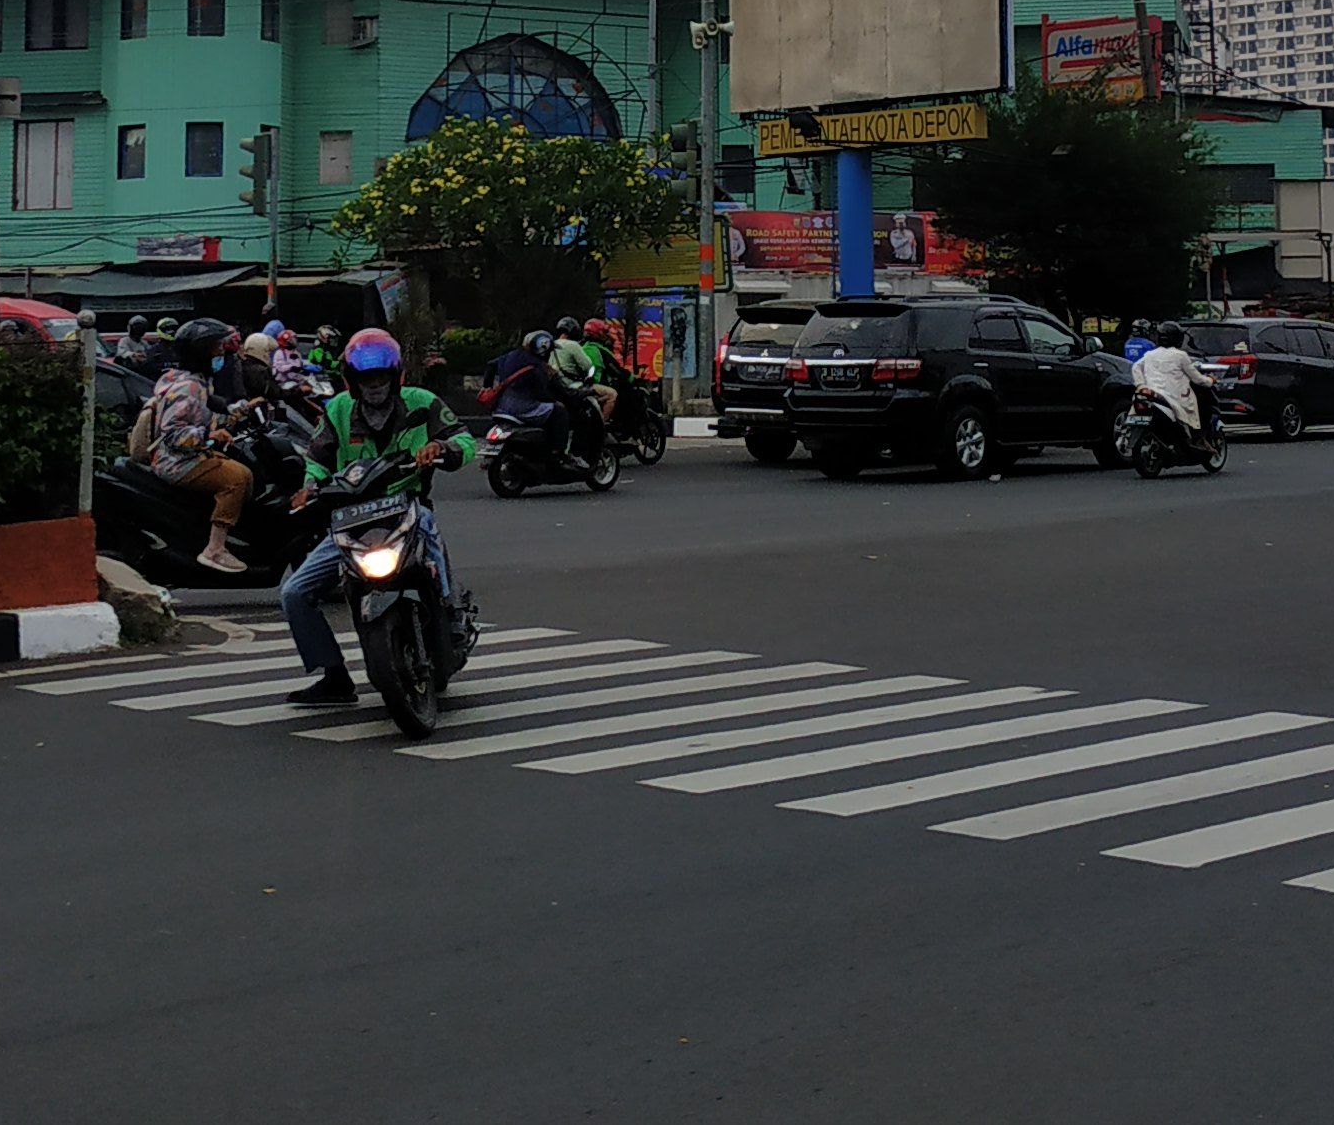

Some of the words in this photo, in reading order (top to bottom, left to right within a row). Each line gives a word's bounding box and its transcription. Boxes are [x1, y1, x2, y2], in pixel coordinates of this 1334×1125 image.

[760, 116, 861, 151] PEMENTAH
[866, 113, 909, 142] KOTA
[913, 107, 974, 138] DEPOK
[746, 228, 770, 237] ROAD
[773, 229, 800, 237] SAFETY
